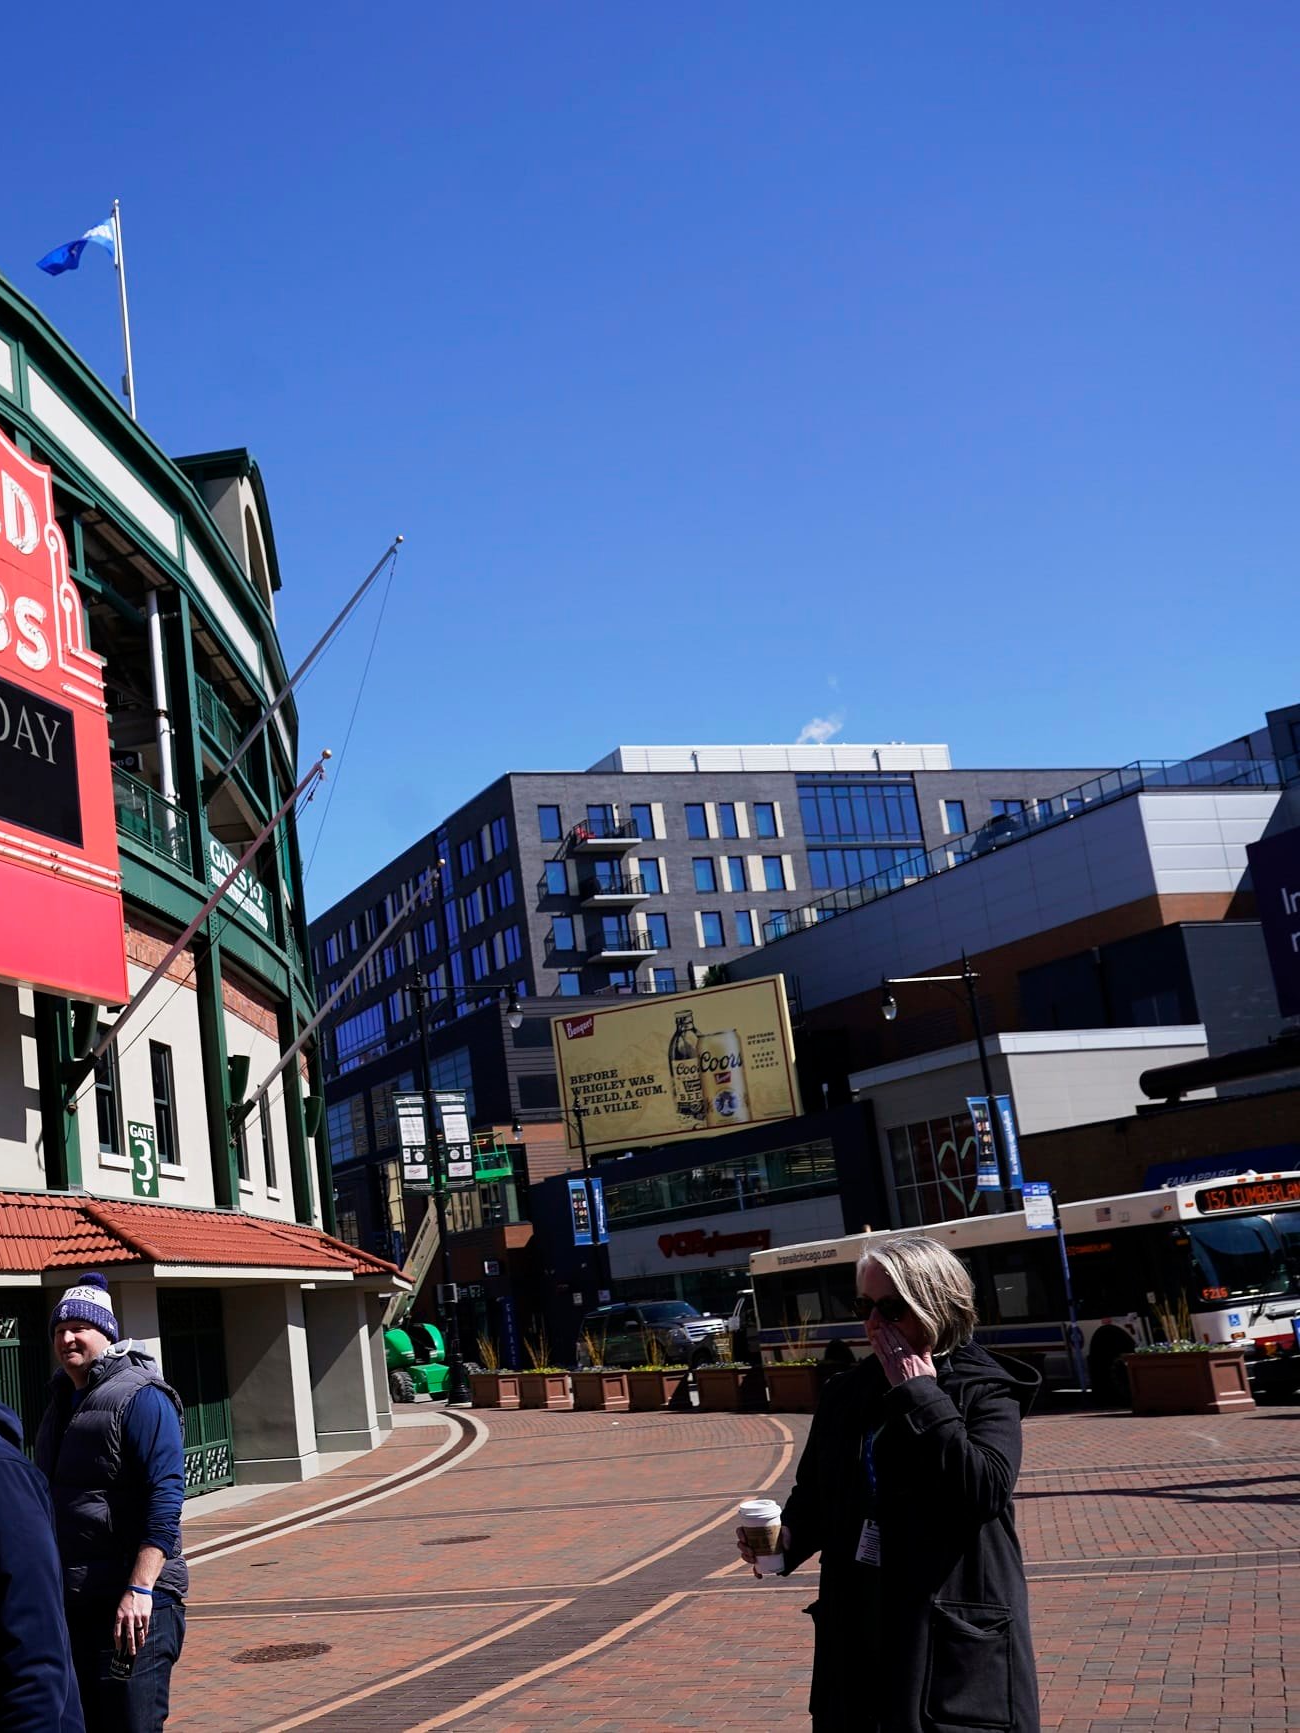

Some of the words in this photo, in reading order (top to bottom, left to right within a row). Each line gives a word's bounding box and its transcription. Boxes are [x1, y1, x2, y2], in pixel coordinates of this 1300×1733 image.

[210, 840, 247, 891] GATS
[570, 1069, 618, 1085] BEFORE
[571, 1079, 626, 1096] WRIGLEY
[629, 1074, 654, 1087] WAS
[625, 1090, 633, 1099] A
[593, 1106, 601, 1115] A
[604, 1100, 642, 1113] VILLE.
[129, 1124, 154, 1141] GATE
[134, 1139, 154, 1181] 3
[1166, 1175, 1188, 1186] FAN
[1205, 1189, 1229, 1211] 152
